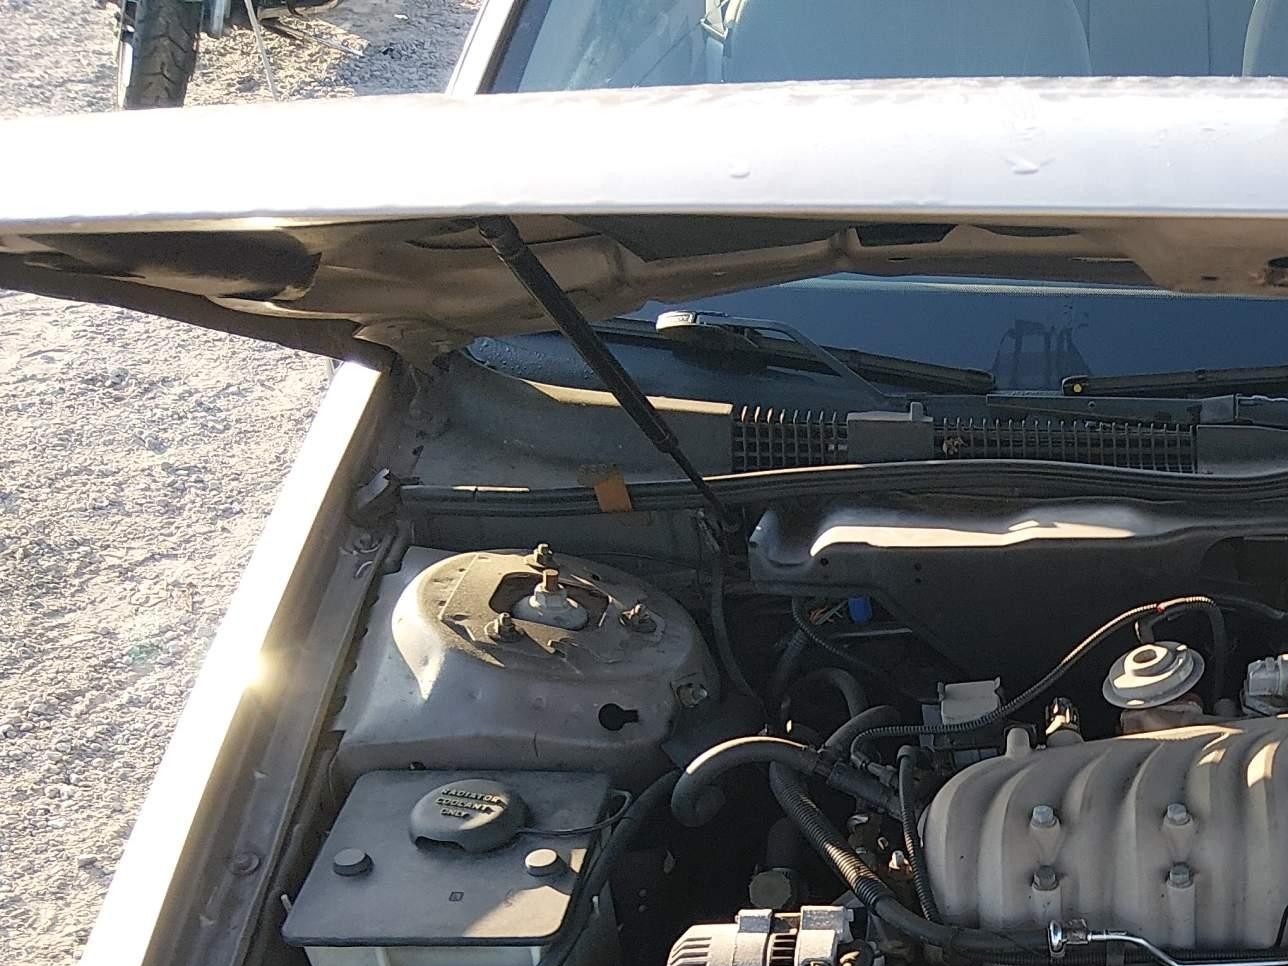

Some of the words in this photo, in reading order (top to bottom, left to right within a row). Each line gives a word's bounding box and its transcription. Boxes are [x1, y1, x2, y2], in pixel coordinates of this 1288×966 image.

[441, 788, 502, 803] RADIATOR
[435, 797, 491, 813] COOLANT
[440, 808, 468, 818] ONLY
